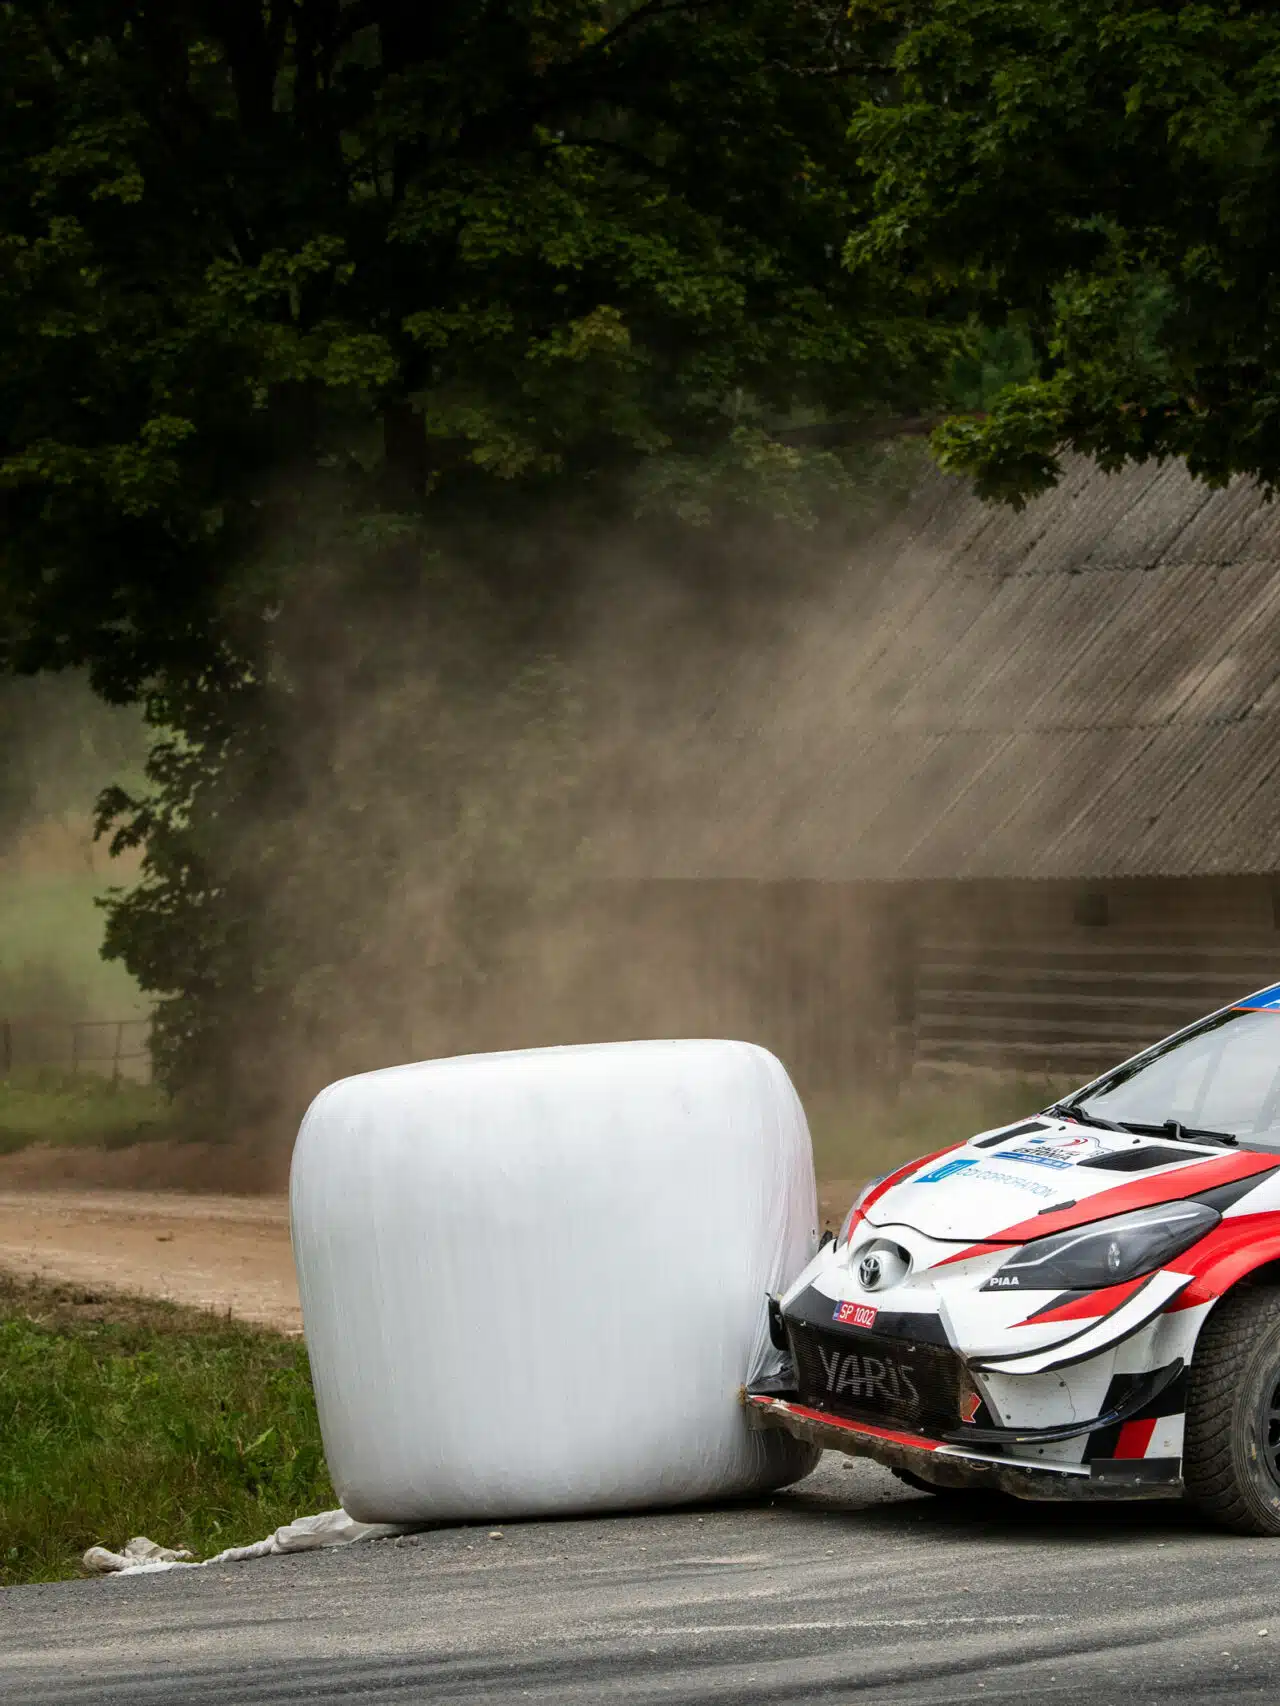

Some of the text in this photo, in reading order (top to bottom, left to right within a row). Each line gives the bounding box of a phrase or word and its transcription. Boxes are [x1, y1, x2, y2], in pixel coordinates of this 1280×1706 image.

[990, 1276, 1020, 1286] PIAA
[838, 1303, 876, 1326] SP 1002
